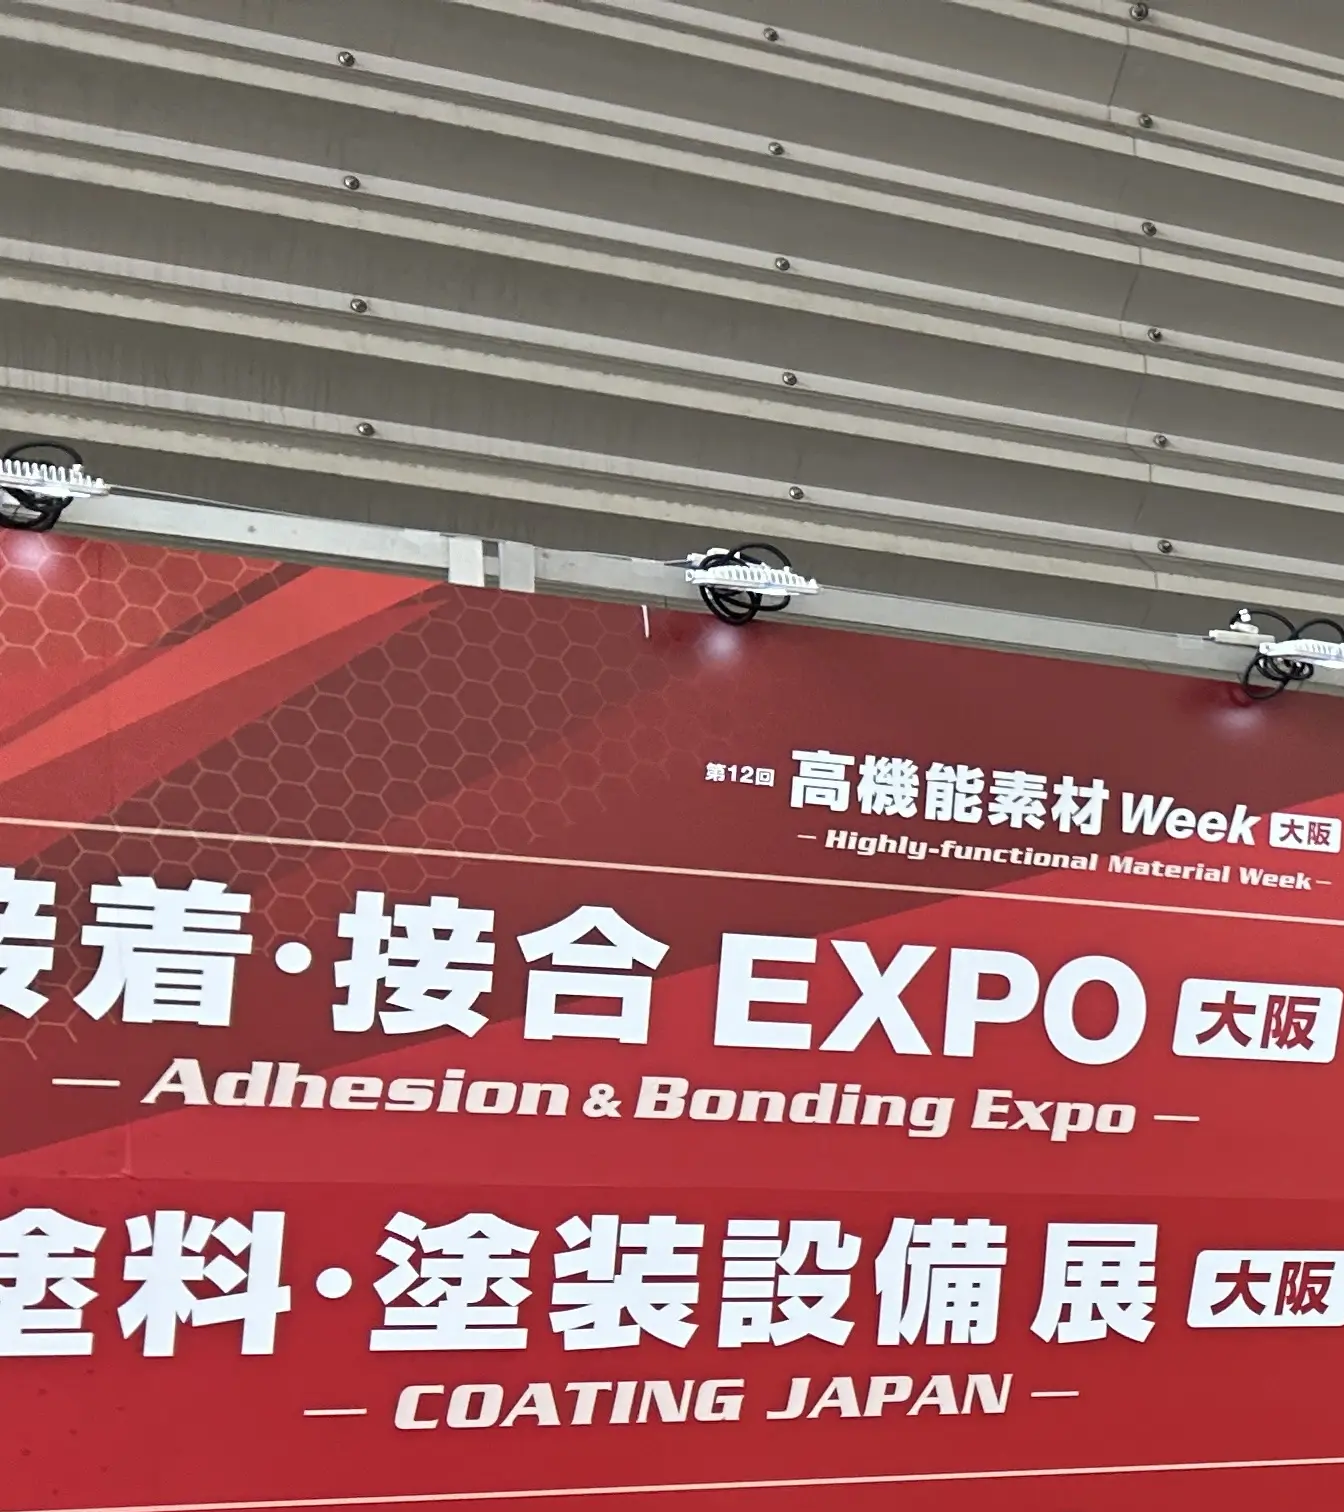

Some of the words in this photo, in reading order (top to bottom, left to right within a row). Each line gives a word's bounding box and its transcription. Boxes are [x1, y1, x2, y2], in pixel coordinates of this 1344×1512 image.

[705, 763, 775, 788] 第12回
[790, 750, 1110, 836] 高機能素材
[1119, 791, 1261, 847] Week
[1279, 819, 1332, 849] 大阪
[824, 829, 1098, 872] Highly-functional
[1107, 854, 1230, 884] Material
[1239, 866, 1312, 891] Week
[714, 932, 1147, 1065] EXPO
[1195, 991, 1322, 1051] 大阪
[141, 1058, 570, 1117] Adhesion
[581, 1083, 623, 1119] &
[633, 1075, 956, 1138] Bonding
[972, 1089, 1136, 1142] Expo
[1210, 1259, 1337, 1317] 大阪
[395, 1378, 745, 1430] COATING
[767, 1373, 1014, 1421] JAPAN
